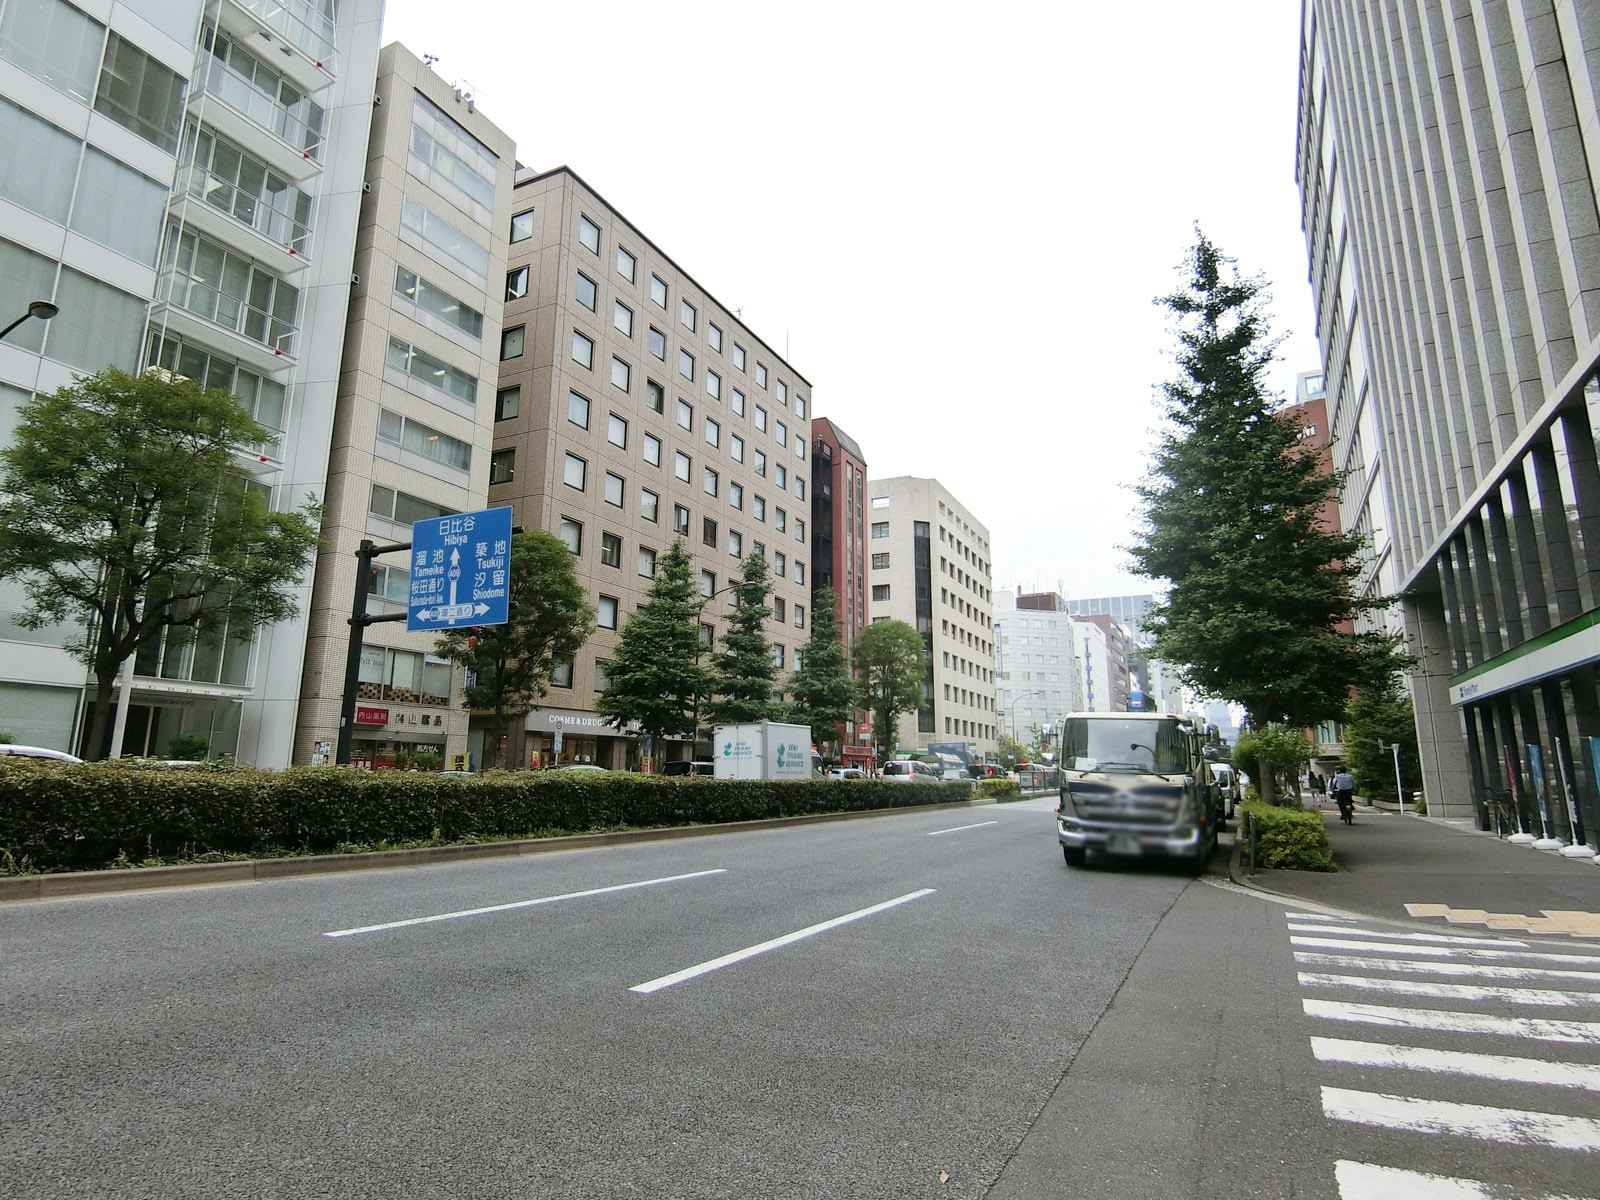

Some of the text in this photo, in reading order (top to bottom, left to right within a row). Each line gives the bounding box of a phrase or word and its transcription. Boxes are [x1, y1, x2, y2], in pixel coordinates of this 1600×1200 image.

[440, 516, 475, 535] 日比谷
[445, 535, 468, 546] Hibiya
[476, 540, 506, 557] 築地
[415, 549, 444, 566] 溜池
[477, 556, 504, 570] Tsukiji
[414, 565, 444, 577] Tameike
[449, 569, 460, 578] 409
[474, 570, 505, 587] 汐留
[412, 577, 445, 595] 桜田通り
[473, 588, 504, 600] Shiodome
[786, 760, 804, 768] SERVICE
